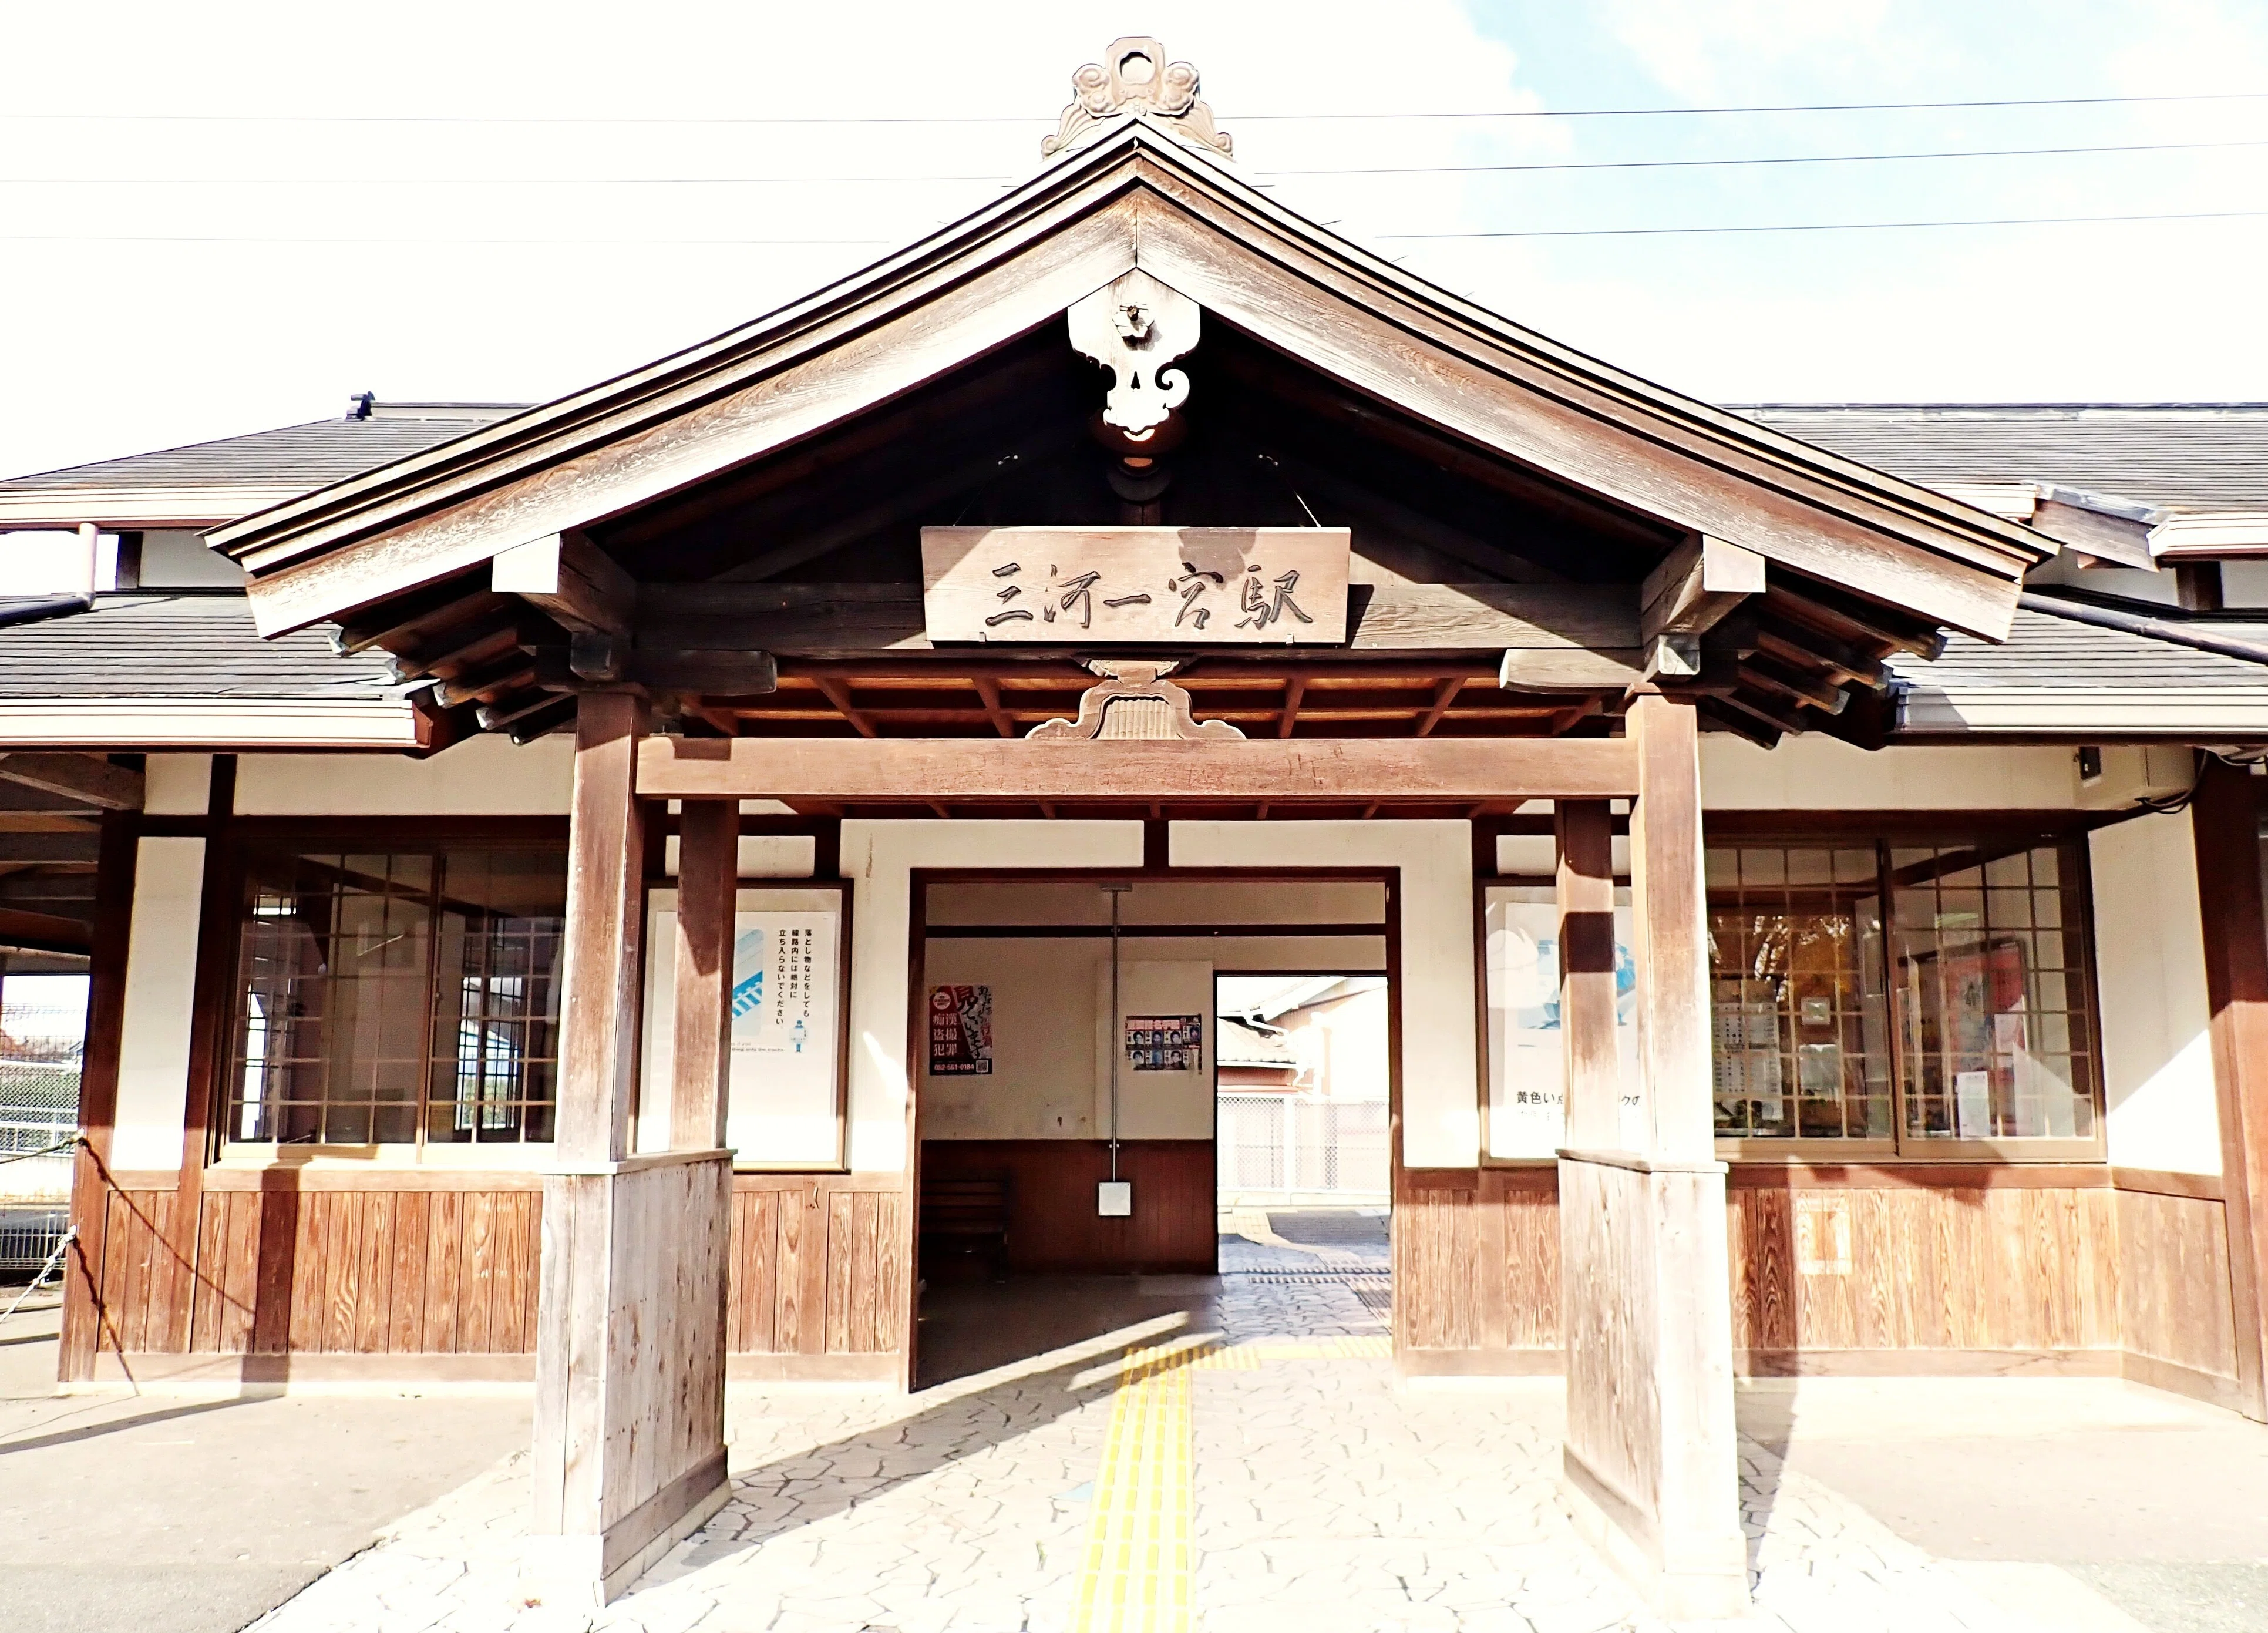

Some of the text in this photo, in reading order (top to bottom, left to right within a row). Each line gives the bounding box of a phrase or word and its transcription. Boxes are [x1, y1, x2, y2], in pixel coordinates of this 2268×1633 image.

[985, 561, 1314, 630] 三河一宮駅
[790, 929, 799, 999] 線路内には絶対に
[803, 929, 813, 1017] 落とし物などをしても
[934, 1043, 958, 1057] 犯罪
